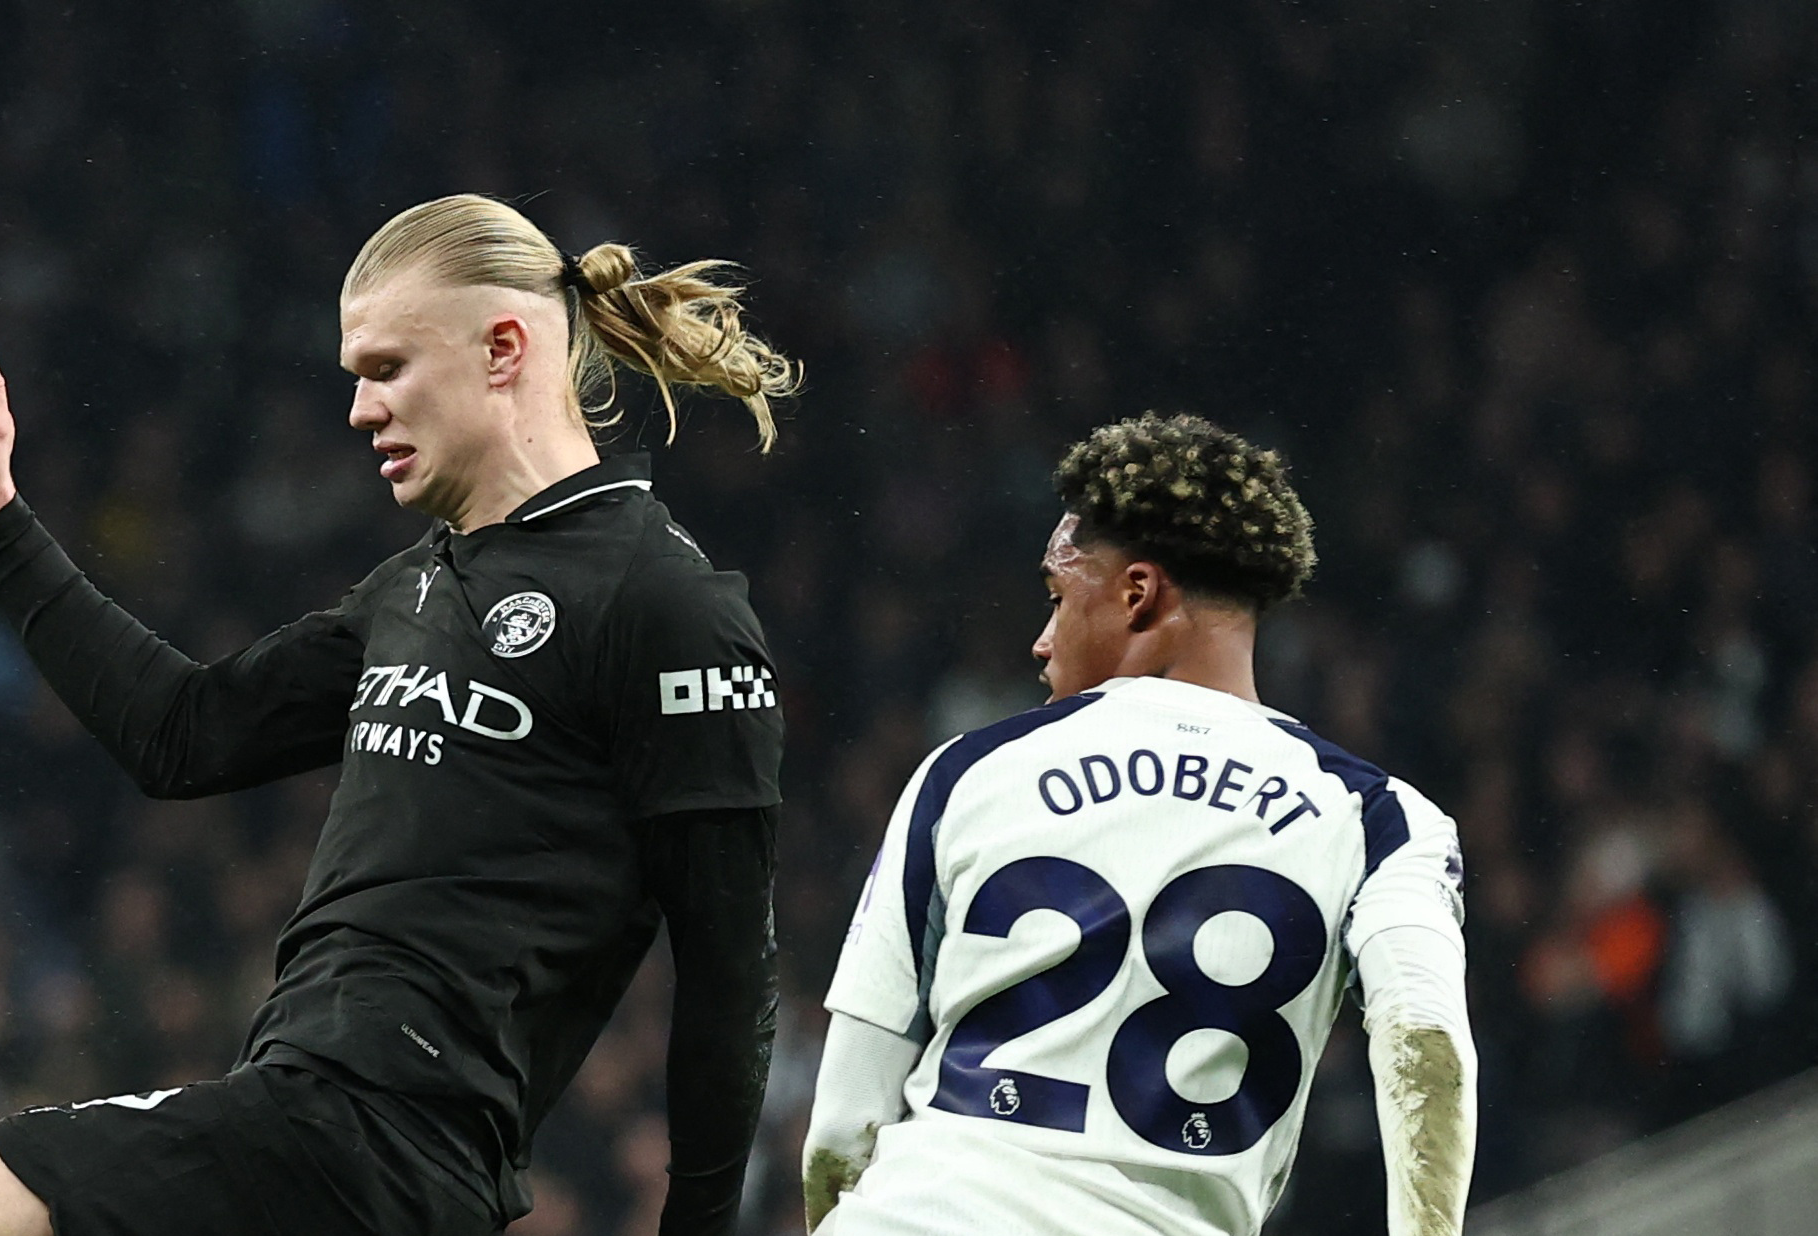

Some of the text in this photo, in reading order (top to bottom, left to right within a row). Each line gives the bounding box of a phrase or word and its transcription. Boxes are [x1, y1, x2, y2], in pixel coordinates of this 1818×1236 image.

[499, 596, 551, 624] MANCHESTER
[349, 664, 533, 741] ETIHAD
[659, 665, 776, 715] OKX
[1176, 722, 1211, 735] 887
[1038, 749, 1322, 836] ODOBERT
[928, 855, 1328, 1157] 28
